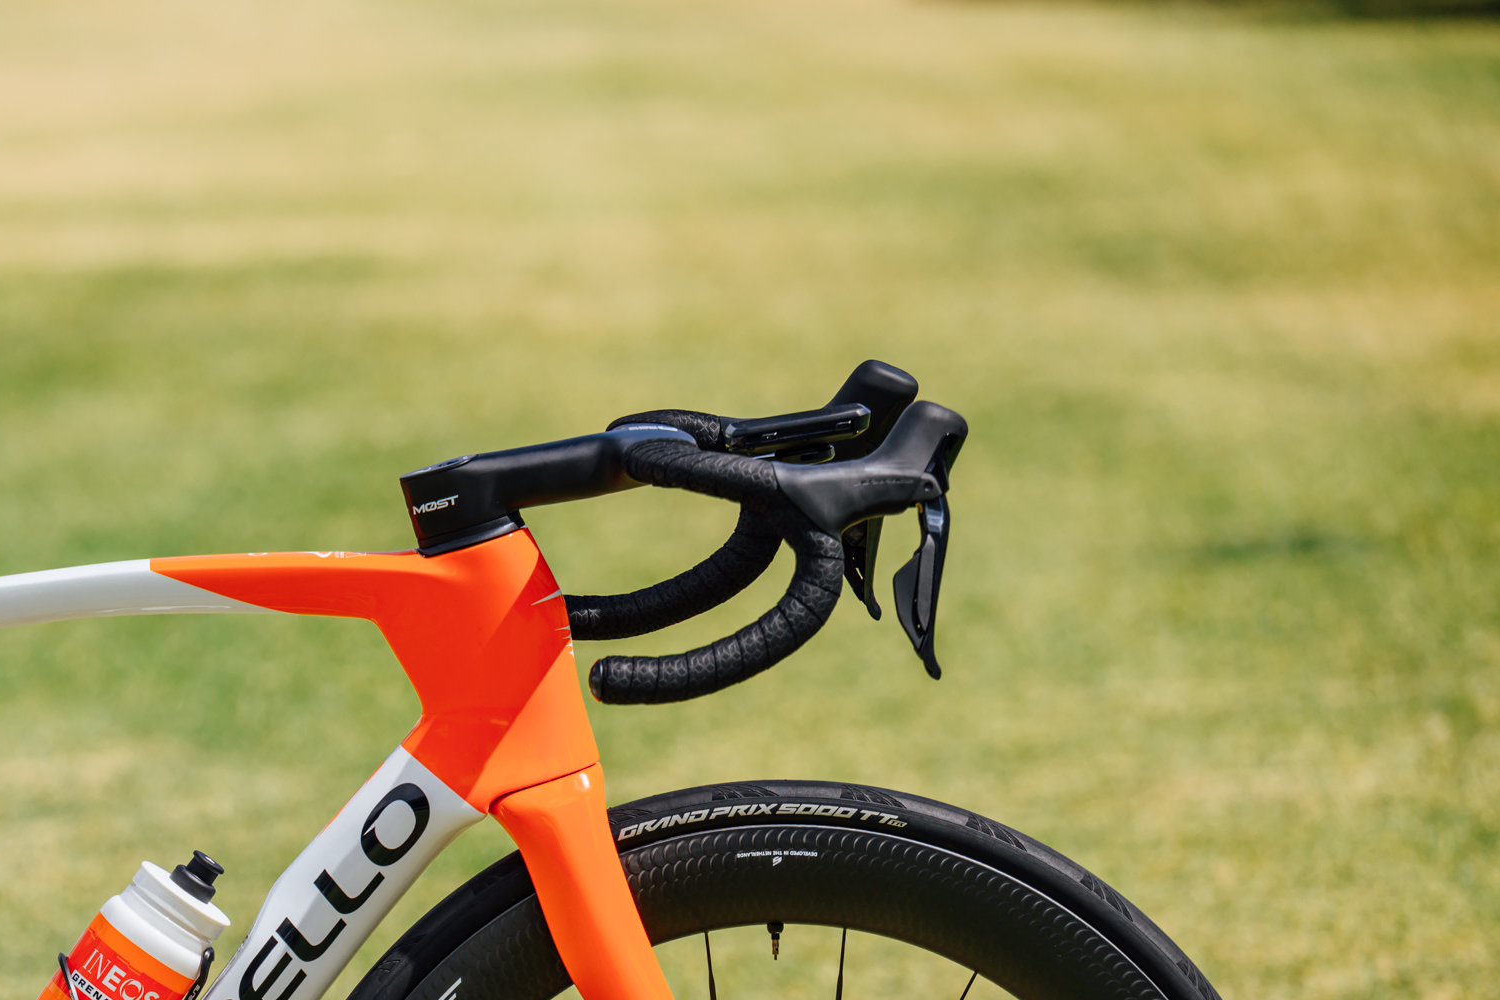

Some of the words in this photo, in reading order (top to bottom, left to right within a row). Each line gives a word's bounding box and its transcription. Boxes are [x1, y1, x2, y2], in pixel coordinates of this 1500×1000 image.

[617, 808, 710, 841] GRAND
[709, 803, 778, 820] PRIX
[775, 803, 858, 819] 5000
[737, 850, 772, 858] NETHERLANDS
